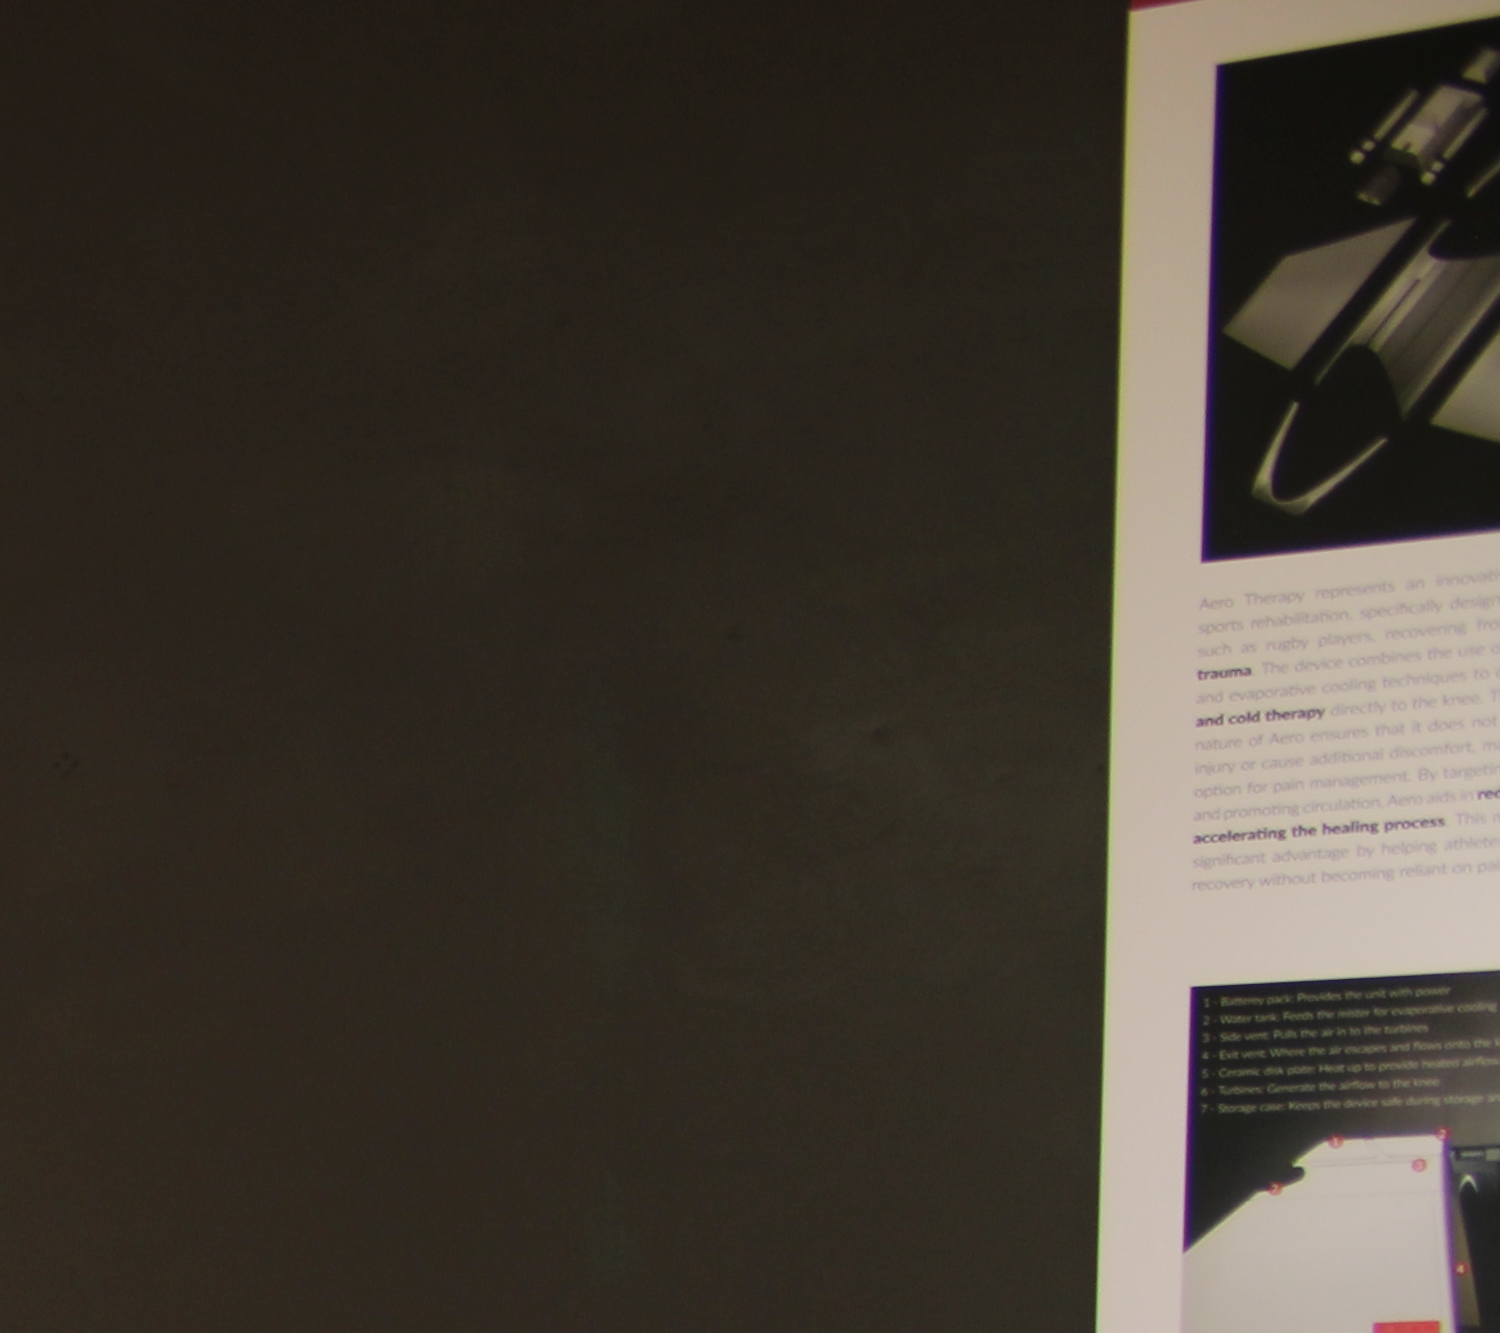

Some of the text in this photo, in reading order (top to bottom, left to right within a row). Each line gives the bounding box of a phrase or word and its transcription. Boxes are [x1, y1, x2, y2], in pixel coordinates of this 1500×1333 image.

[1196, 712, 1224, 727] and
[1227, 709, 1261, 725] cold
[1265, 704, 1325, 725] therapy
[1193, 826, 1286, 849] accelerating
[1291, 823, 1316, 838] the
[1321, 819, 1379, 840] healing
[1384, 817, 1447, 836] process.
